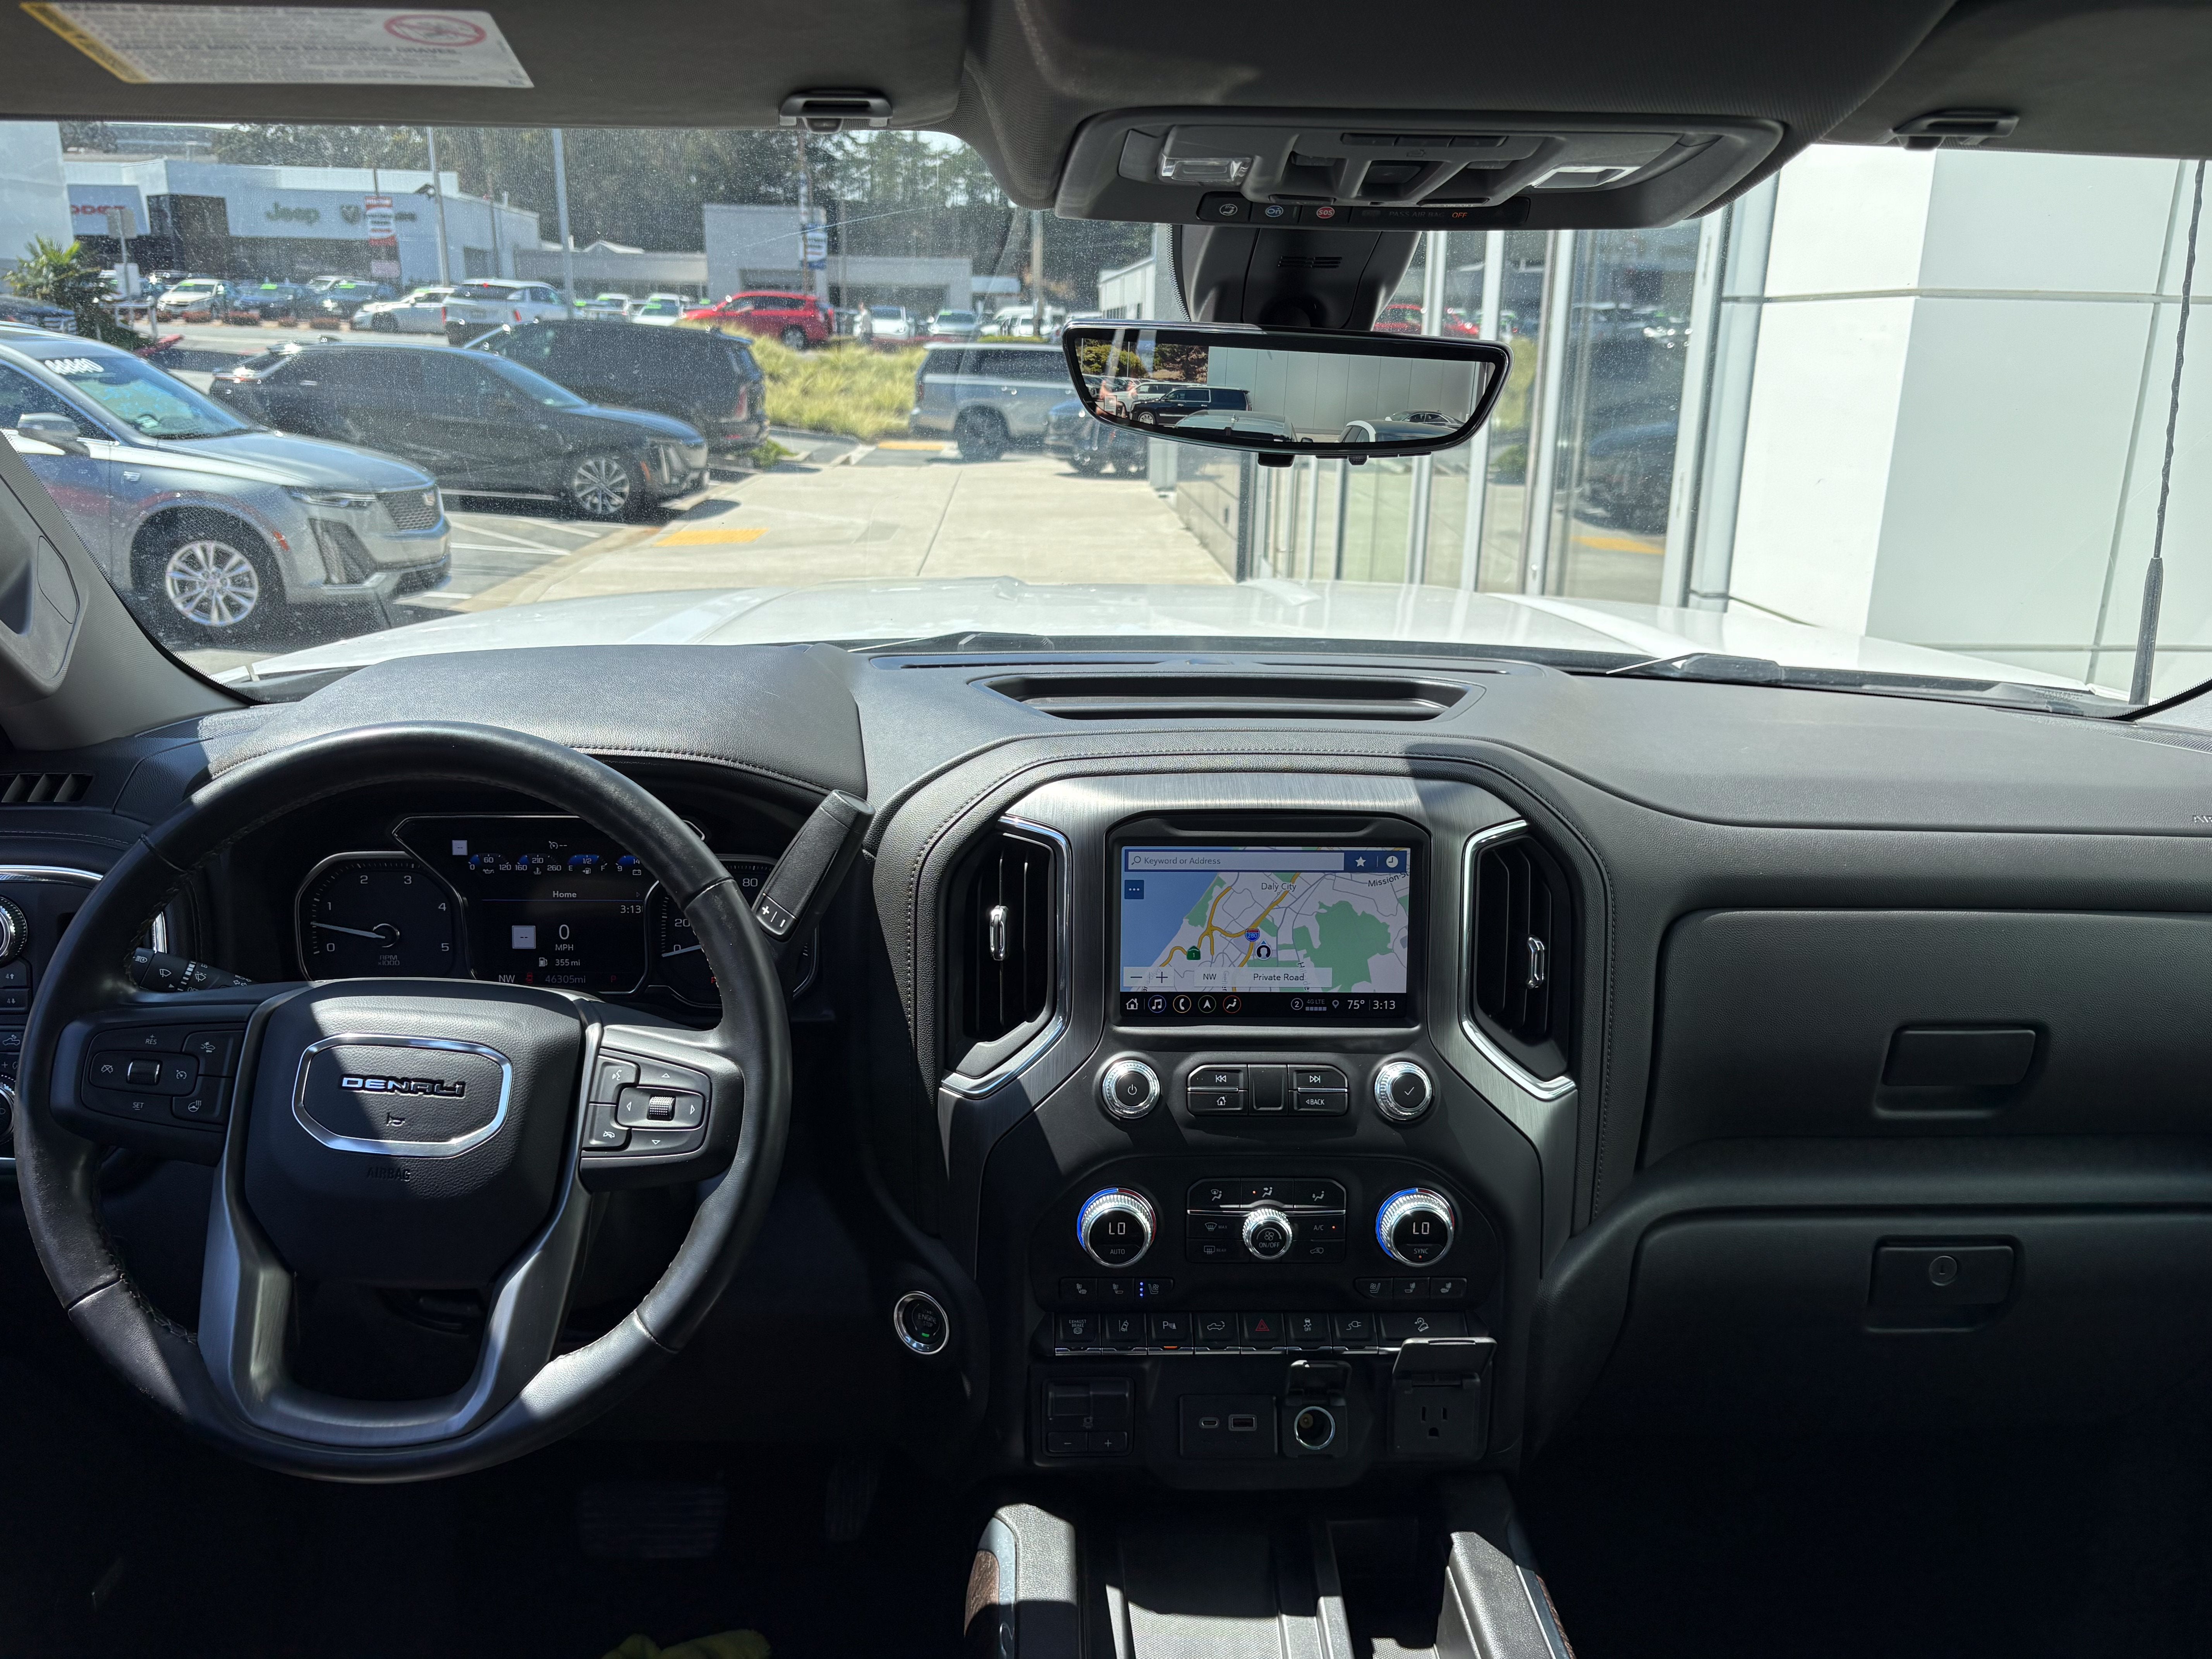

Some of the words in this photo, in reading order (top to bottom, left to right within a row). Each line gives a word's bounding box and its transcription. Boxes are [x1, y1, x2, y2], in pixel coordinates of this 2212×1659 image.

[1144, 857, 1177, 866] Keyword
[360, 875, 368, 884] 2
[404, 875, 412, 884] 3
[742, 878, 758, 887] 80
[1262, 883, 1279, 891] Daly
[1281, 883, 1297, 891] City
[327, 902, 332, 910] 1
[438, 903, 447, 911] 4
[620, 905, 641, 914] 3:13
[674, 919, 690, 927] 20
[559, 924, 570, 940] 0
[326, 943, 335, 952] 0
[441, 943, 450, 951] 5
[498, 974, 515, 983] NW
[1347, 1000, 1365, 1010] 75°
[1373, 1000, 1396, 1010] 3:13
[341, 1077, 464, 1095] DENALI
[368, 1167, 410, 1181] AIRBAG
[918, 1313, 936, 1324] ENGINE
